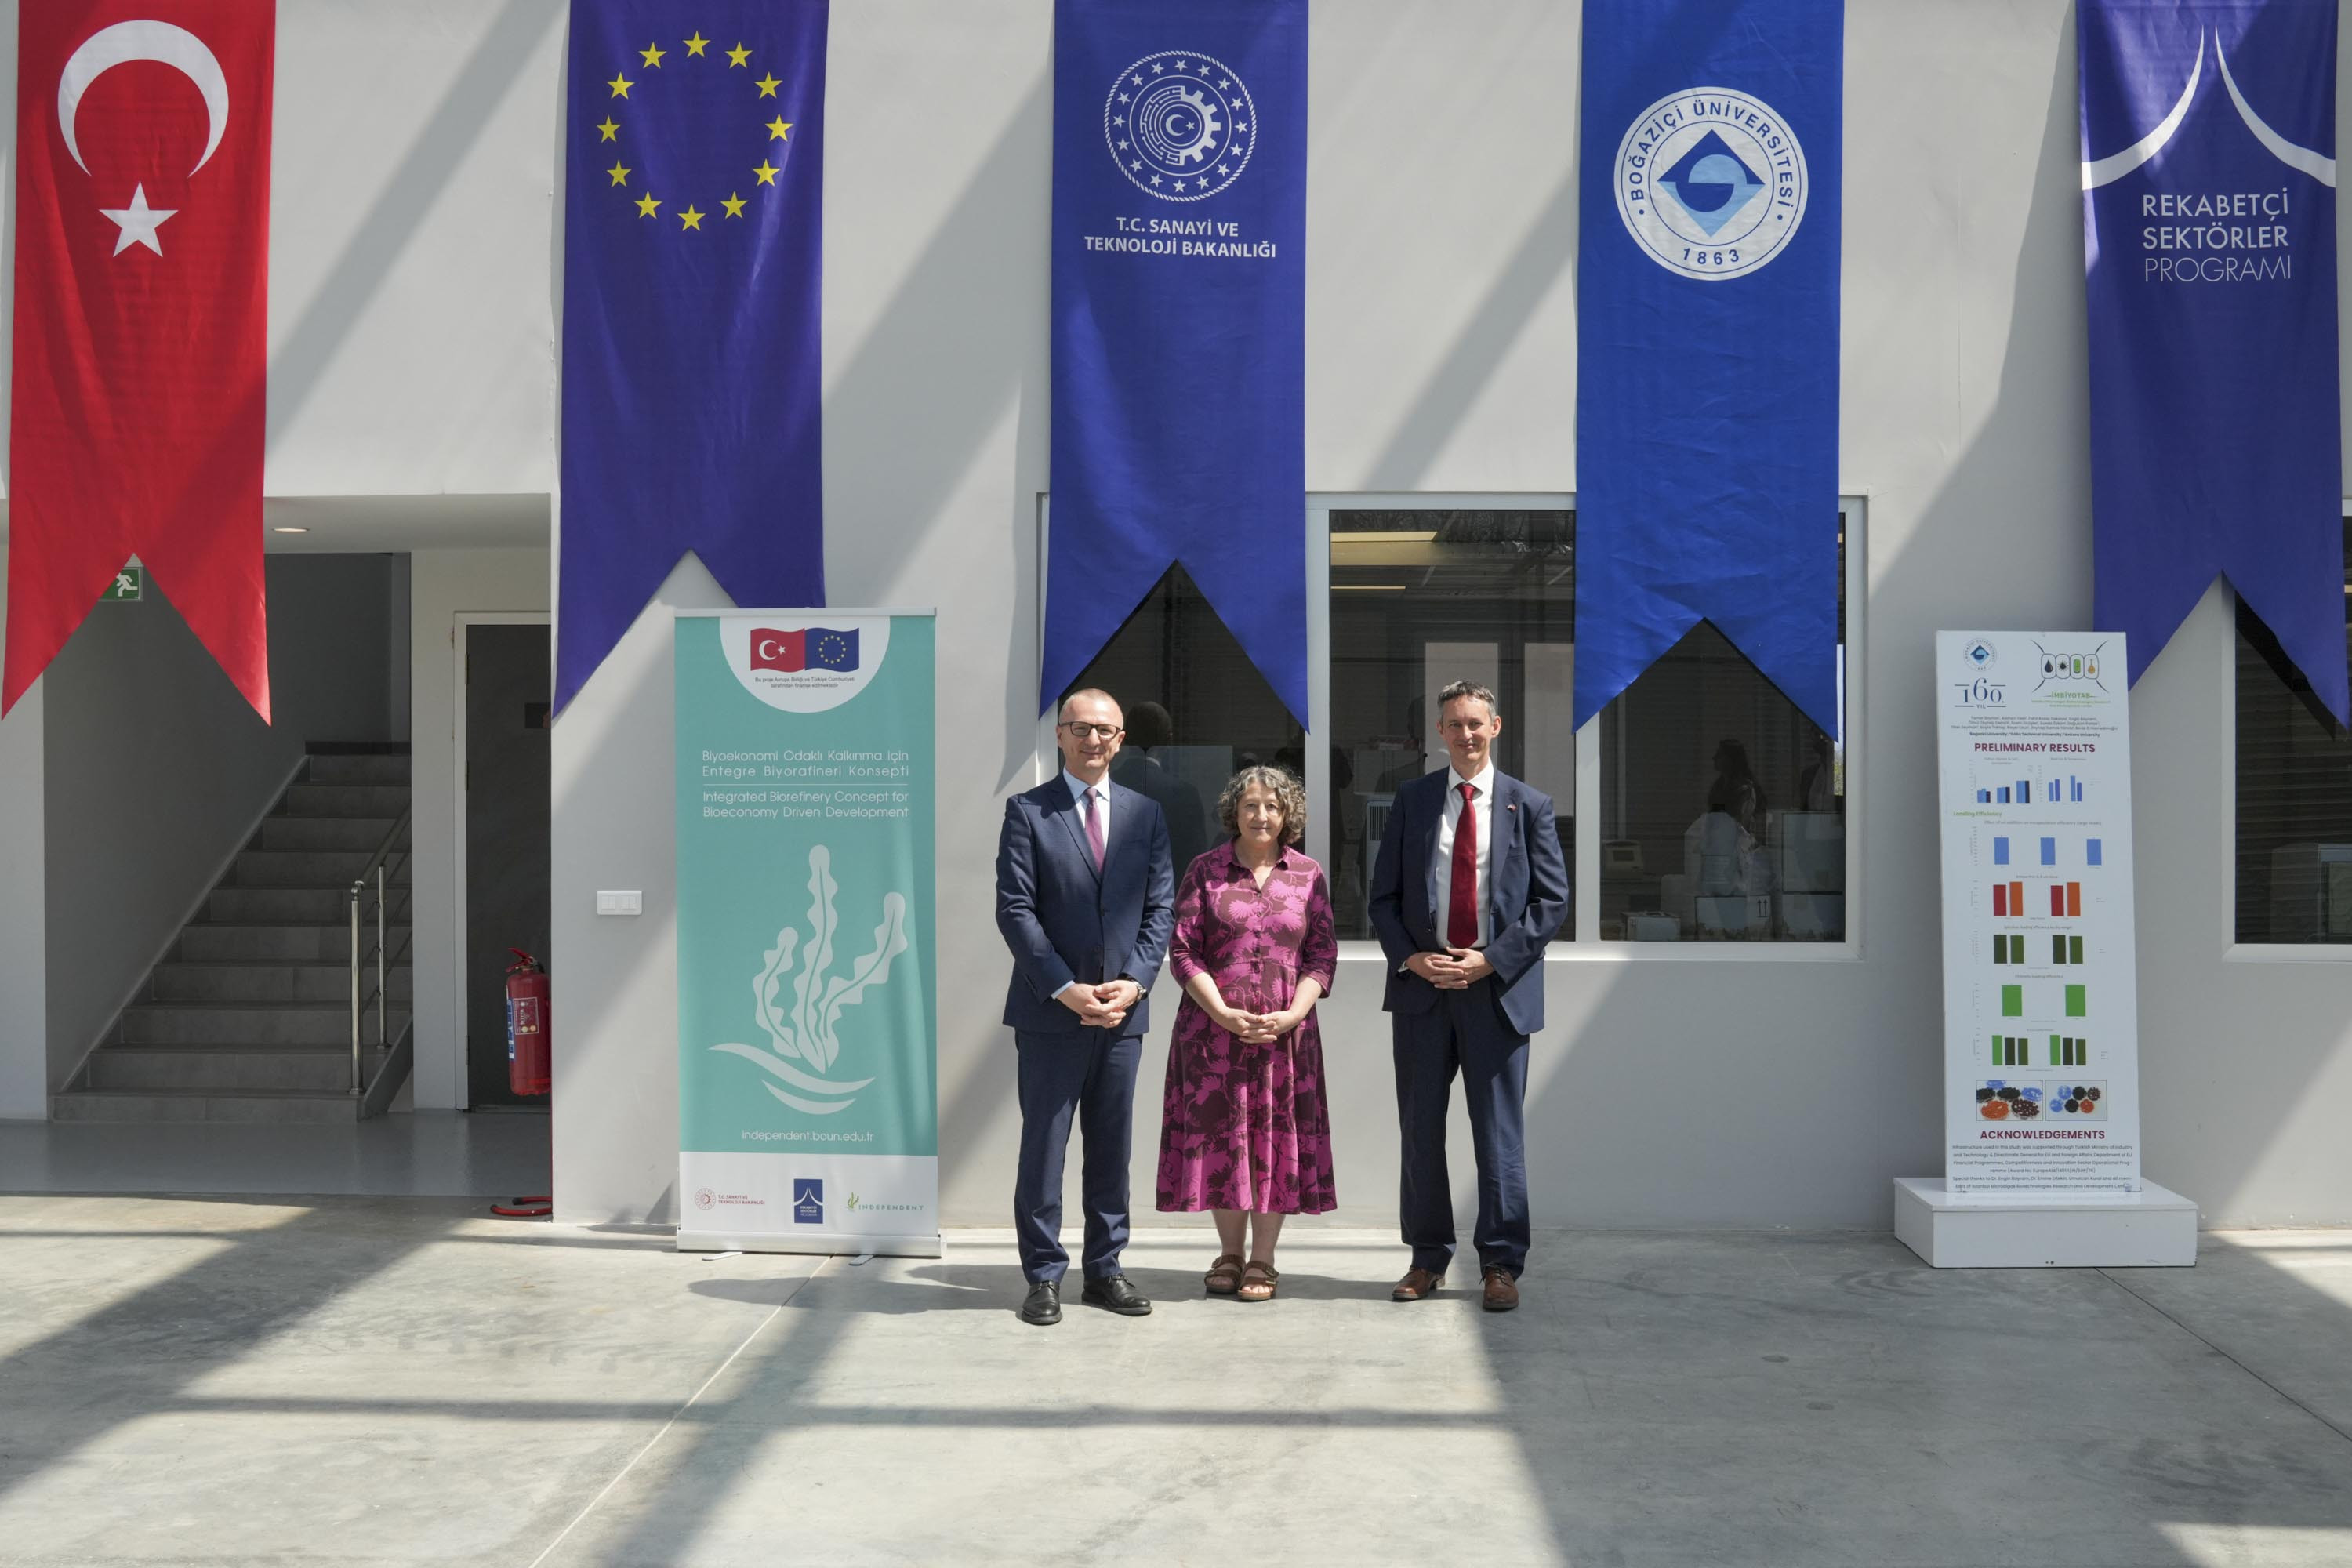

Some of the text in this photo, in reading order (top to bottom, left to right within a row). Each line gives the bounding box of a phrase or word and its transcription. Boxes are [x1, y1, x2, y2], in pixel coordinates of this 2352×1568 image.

[1628, 99, 1794, 208] BOĞAZİÇİ ÜNİVERSİTESİ
[2143, 187, 2288, 222] REKABETÇİ
[1116, 217, 1239, 237] T.C. SANAYİ VE
[2143, 222, 2289, 249] SEKTÖRLER
[1084, 236, 1276, 258] TEKNOLOJİ BAKANLIĞI
[1683, 247, 1740, 265] 1863
[2145, 255, 2291, 283] PROGRAMI
[1974, 743, 2096, 753] PRELIMINARY RESULTS
[702, 750, 779, 763] Biyoekonomi
[783, 750, 822, 761] Odaklı
[828, 750, 882, 761] Kalkınma
[702, 765, 909, 779] Entegre Biyorafineri Konsepti
[703, 791, 909, 804] Integrated Biorefinery Concept for
[703, 806, 909, 819] Bioeconomy Driven Development
[742, 1131, 874, 1142] independent.boun.edu.tr
[1980, 1130, 2105, 1139] ACKNOWLEDGEMENTS
